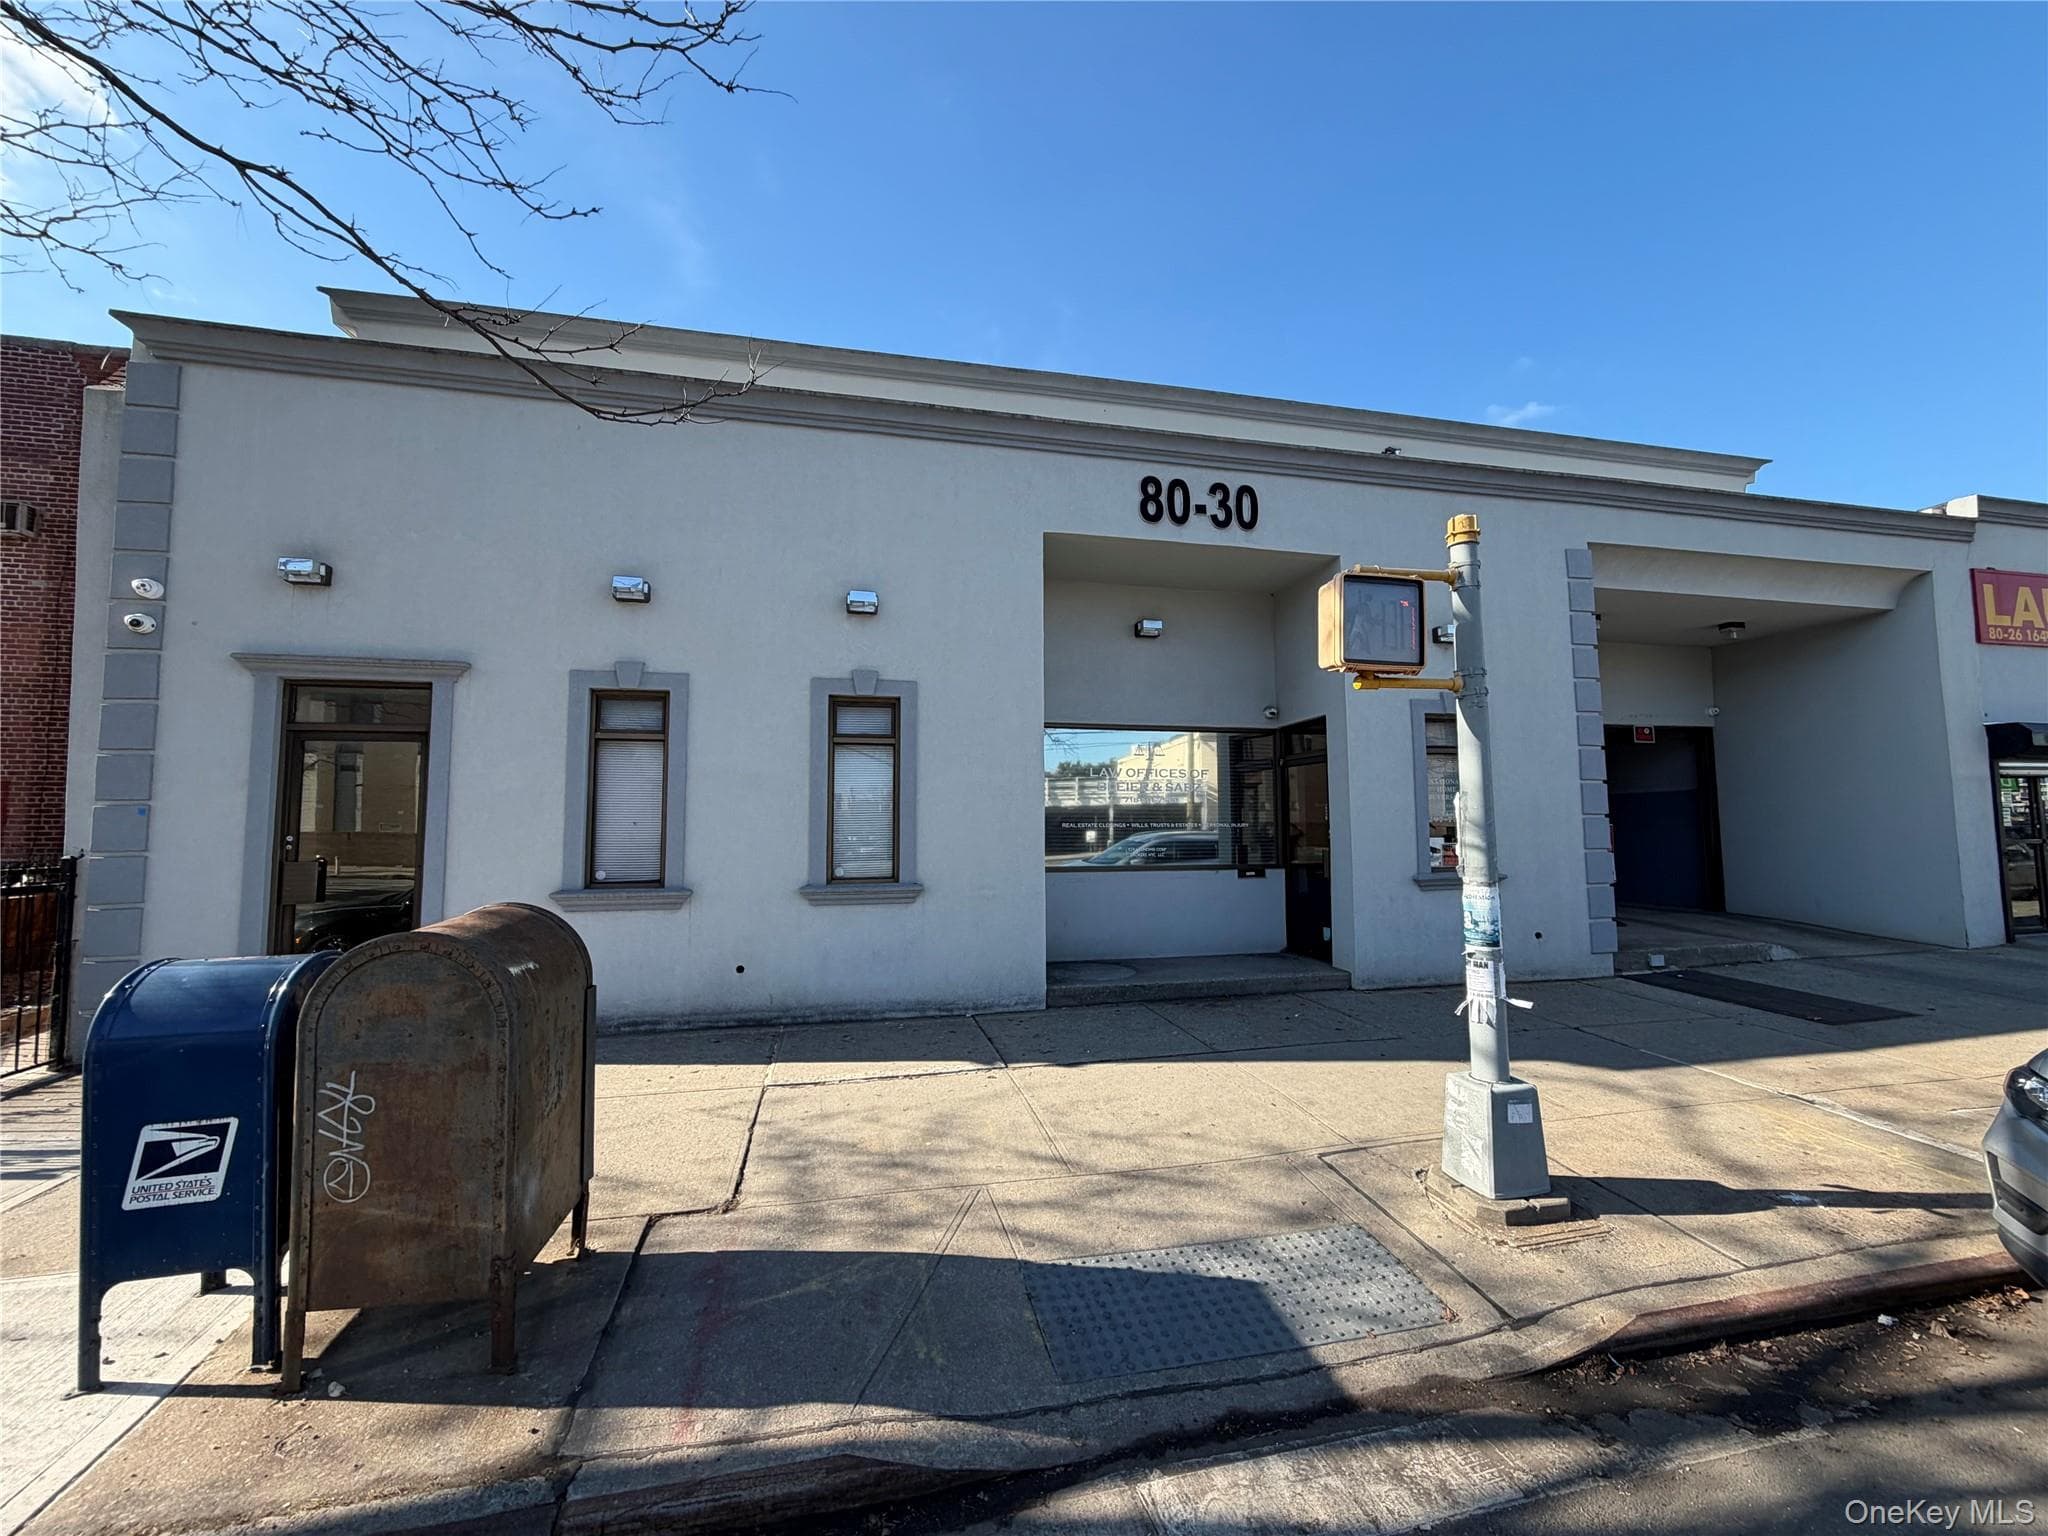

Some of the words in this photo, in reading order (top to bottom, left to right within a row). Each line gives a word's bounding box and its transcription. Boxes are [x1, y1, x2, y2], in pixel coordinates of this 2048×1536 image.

[1140, 475, 1259, 530] 80-30
[1988, 627, 2023, 640] 80-26
[2026, 629, 2048, 642] 164
[1089, 767, 1123, 777] LAW
[1125, 767, 1187, 779] OFFICES
[1189, 768, 1209, 779] OF
[1097, 782, 1150, 792] BEIER
[1152, 782, 1163, 792] &
[131, 1182, 174, 1194] UNITED
[175, 1177, 213, 1190] STATES
[128, 1193, 170, 1205] POSTAL
[172, 1187, 216, 1200] SERVICE
